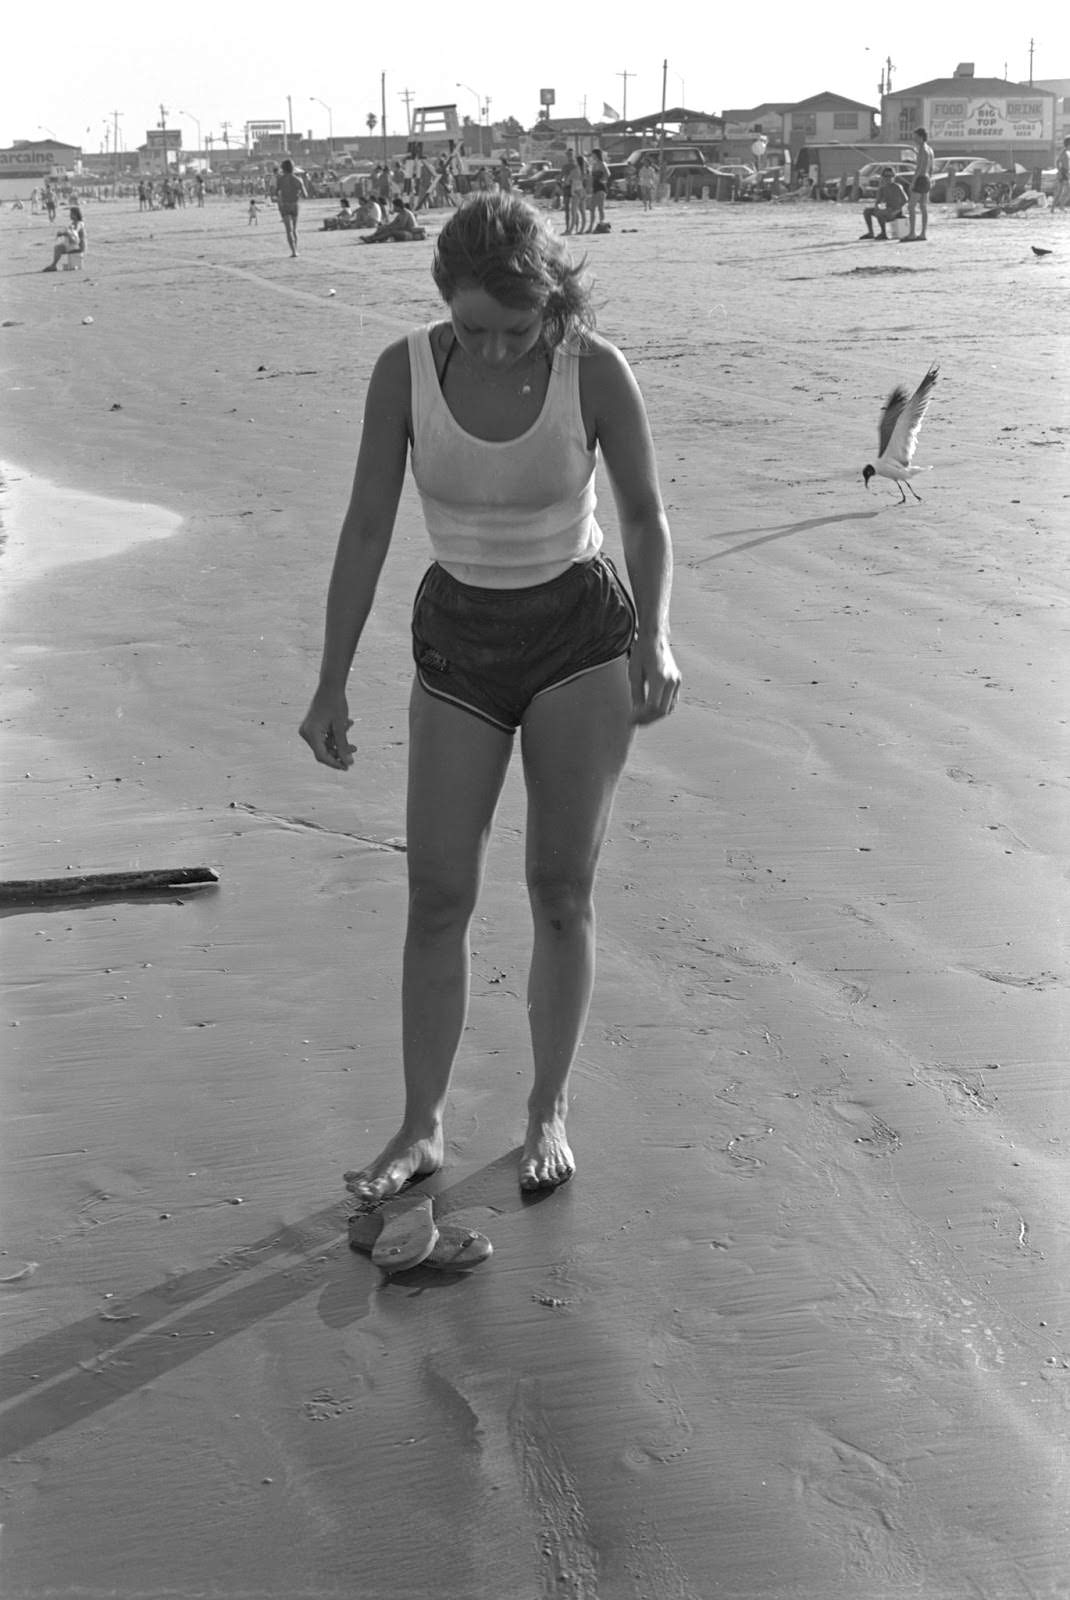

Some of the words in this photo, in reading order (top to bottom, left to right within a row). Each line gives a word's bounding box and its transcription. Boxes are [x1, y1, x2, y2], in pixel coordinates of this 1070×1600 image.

[935, 103, 964, 115] FOOD
[1007, 103, 1042, 115] DRINK
[978, 110, 996, 118] BIG
[975, 118, 997, 127] TOP
[967, 128, 1004, 136] BURGERS
